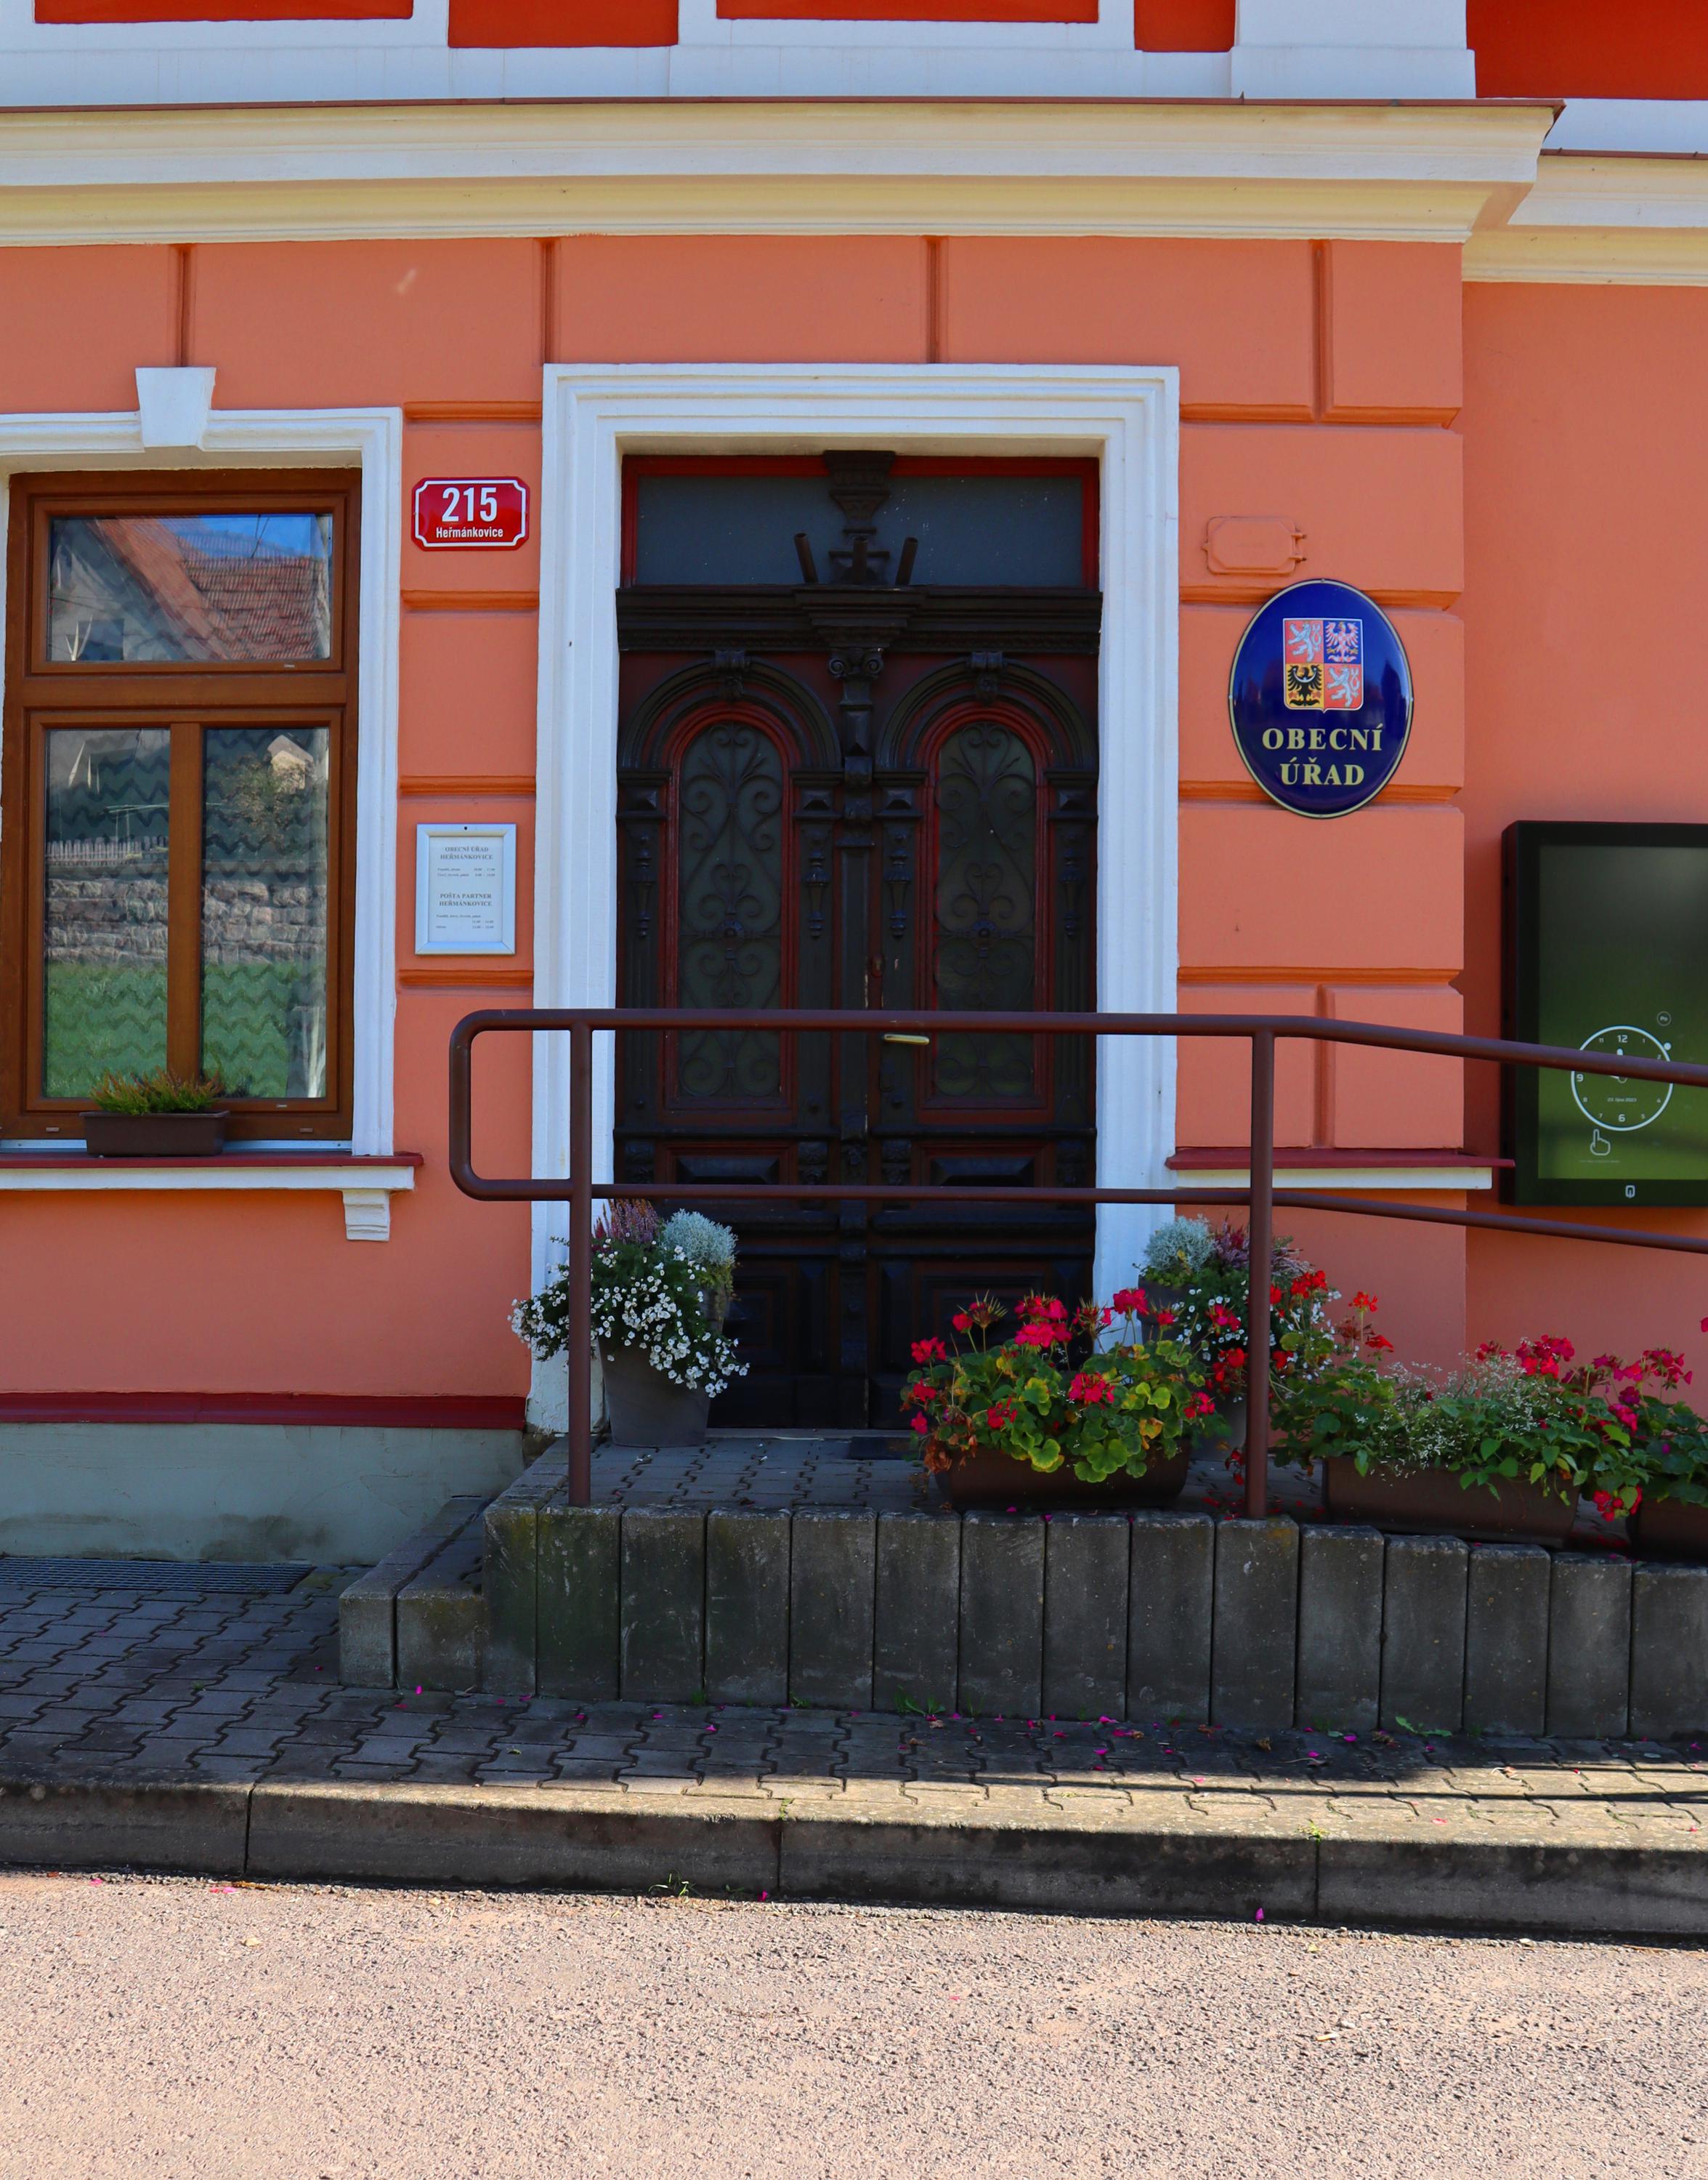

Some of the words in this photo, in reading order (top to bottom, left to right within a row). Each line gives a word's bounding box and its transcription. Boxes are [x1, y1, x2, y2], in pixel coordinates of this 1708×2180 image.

[442, 487, 498, 522] 215
[436, 527, 503, 538] Heřmánkovice
[1262, 723, 1383, 751] OBECNÍ
[1279, 756, 1365, 786] ÚŘAD
[1617, 1035, 1628, 1043] 12
